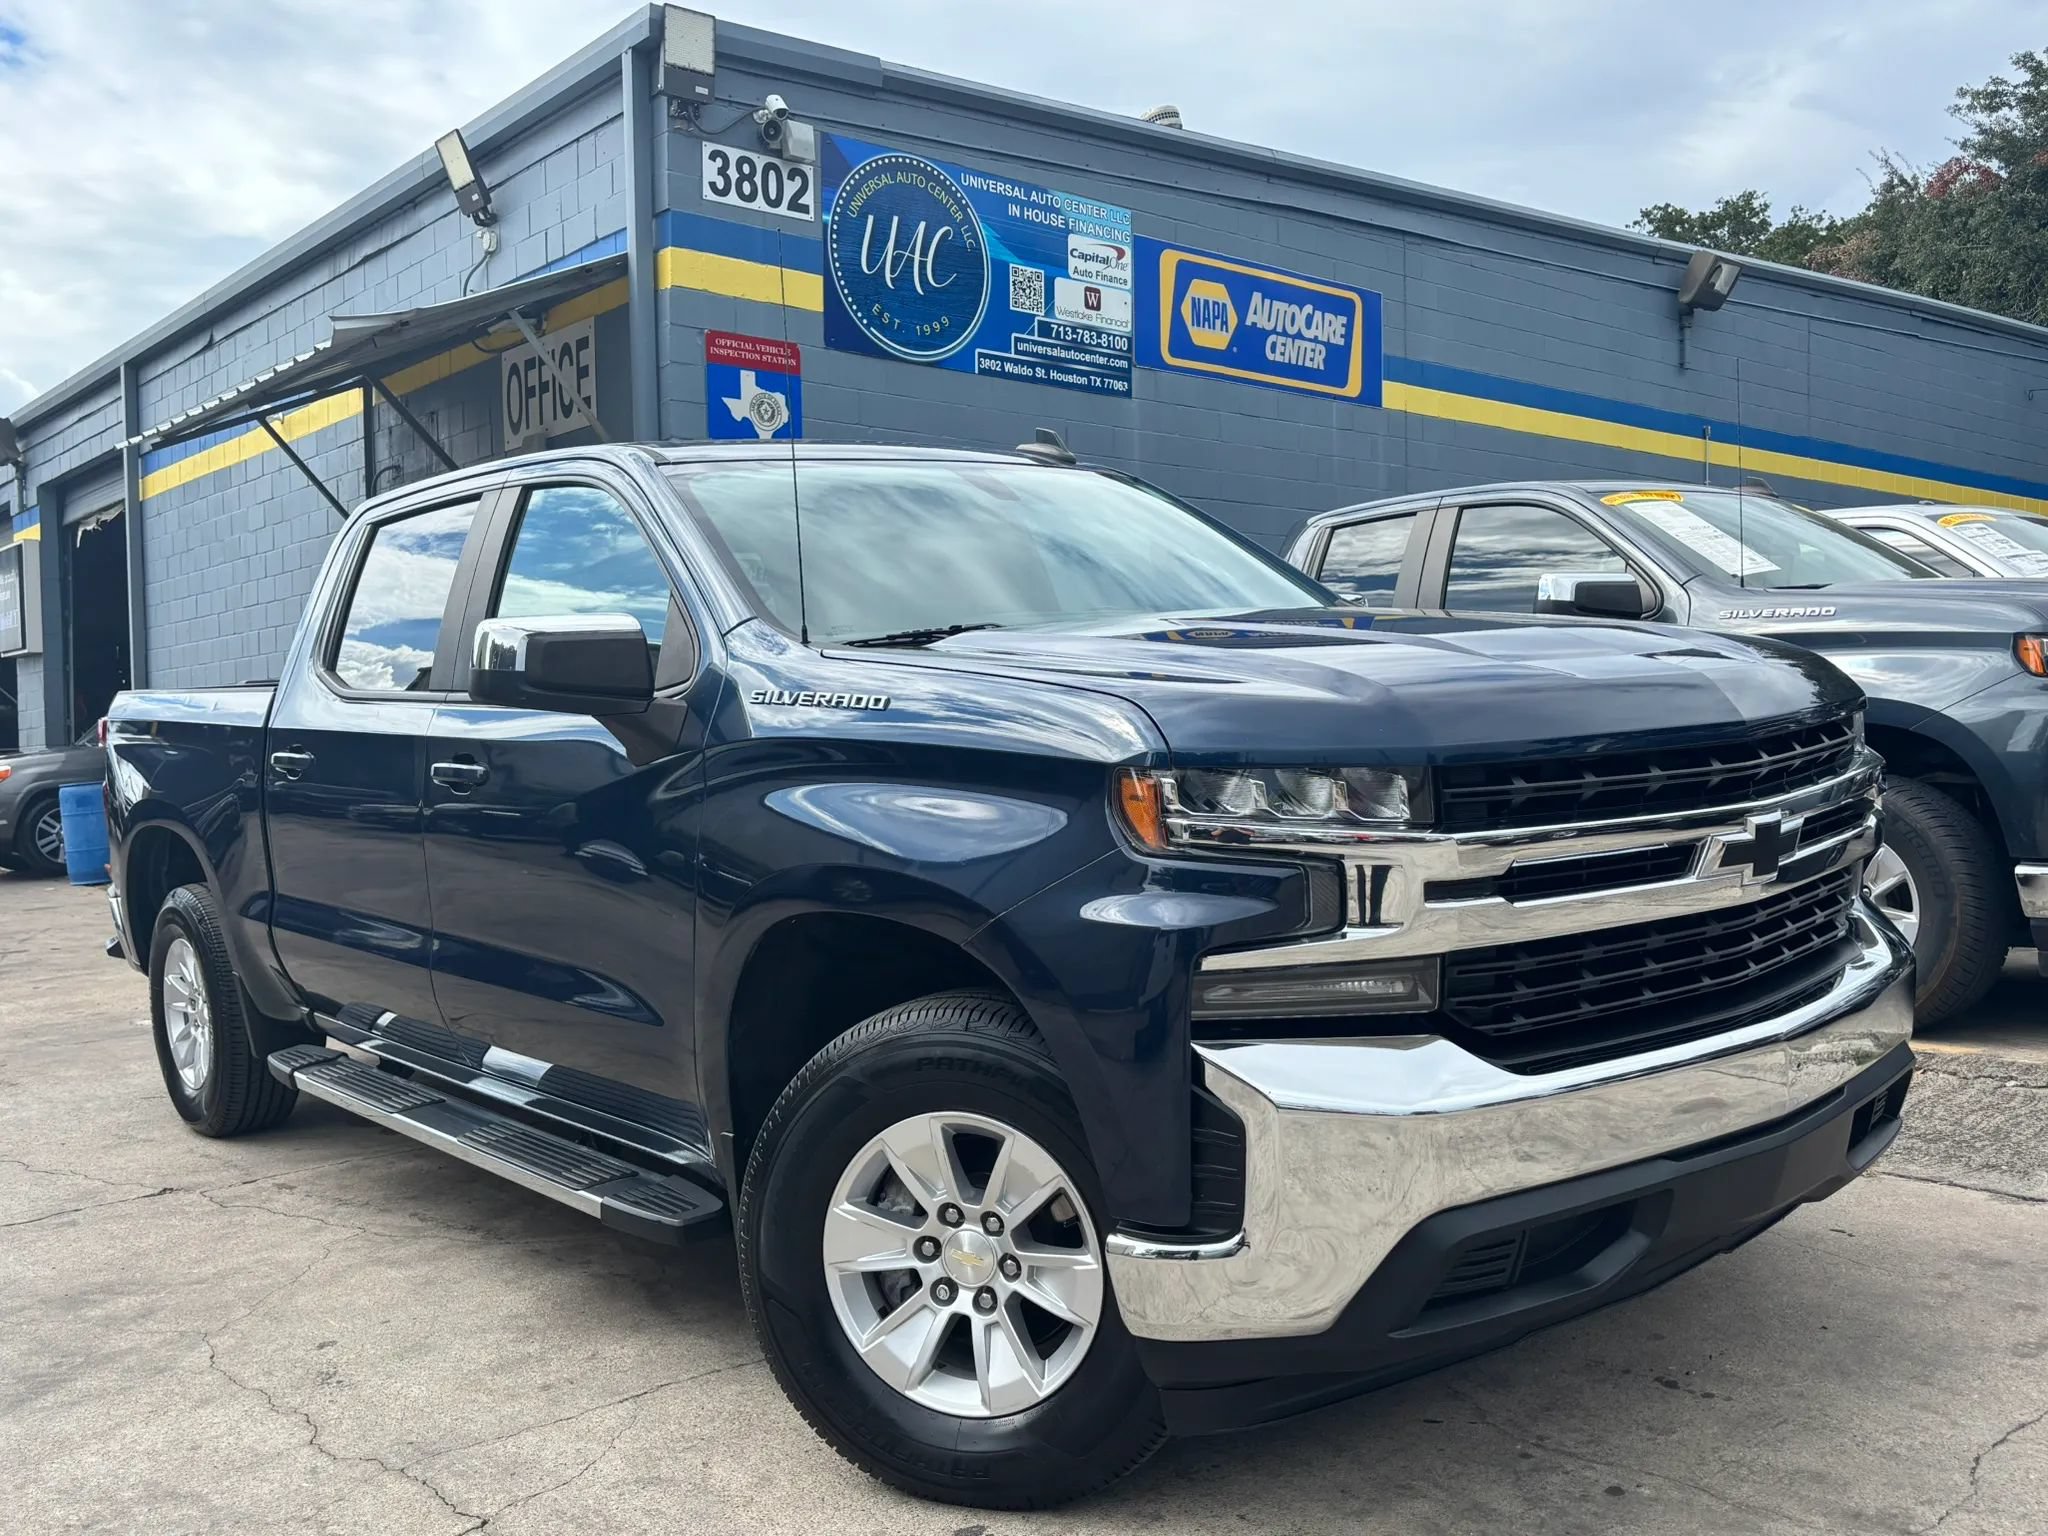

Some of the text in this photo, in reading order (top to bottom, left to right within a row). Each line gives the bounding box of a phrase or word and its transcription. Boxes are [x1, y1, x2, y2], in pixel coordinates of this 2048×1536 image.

[708, 150, 810, 215] 3802
[846, 172, 895, 218] UNIVERSAL
[896, 171, 926, 188] AUTO
[927, 182, 964, 222] CENTER
[961, 173, 1131, 225] UNIVERSAL AUTO CENTER LLC
[1008, 203, 1131, 243] IN HOUSE FINANCING
[861, 214, 957, 295] UAC
[1073, 266, 1128, 286] Auto Finance
[1086, 291, 1100, 308] W
[916, 316, 950, 336] 1999
[1056, 306, 1129, 328] Westlake Financial
[1190, 296, 1229, 333] NAPA
[715, 338, 792, 357] OFFICIAL VEHICLE
[1050, 324, 1128, 351] 713-783-8100
[710, 346, 797, 366] INSPECTION STATION
[1017, 341, 1128, 369] universalautocenter.com
[1265, 334, 1327, 370] CENTER
[507, 335, 592, 436] OFFICE
[979, 358, 1129, 392] 3802 Waldo St. Houston TX 77063
[1719, 606, 1837, 620] SILVERADO
[749, 689, 891, 711] SILVERADO
